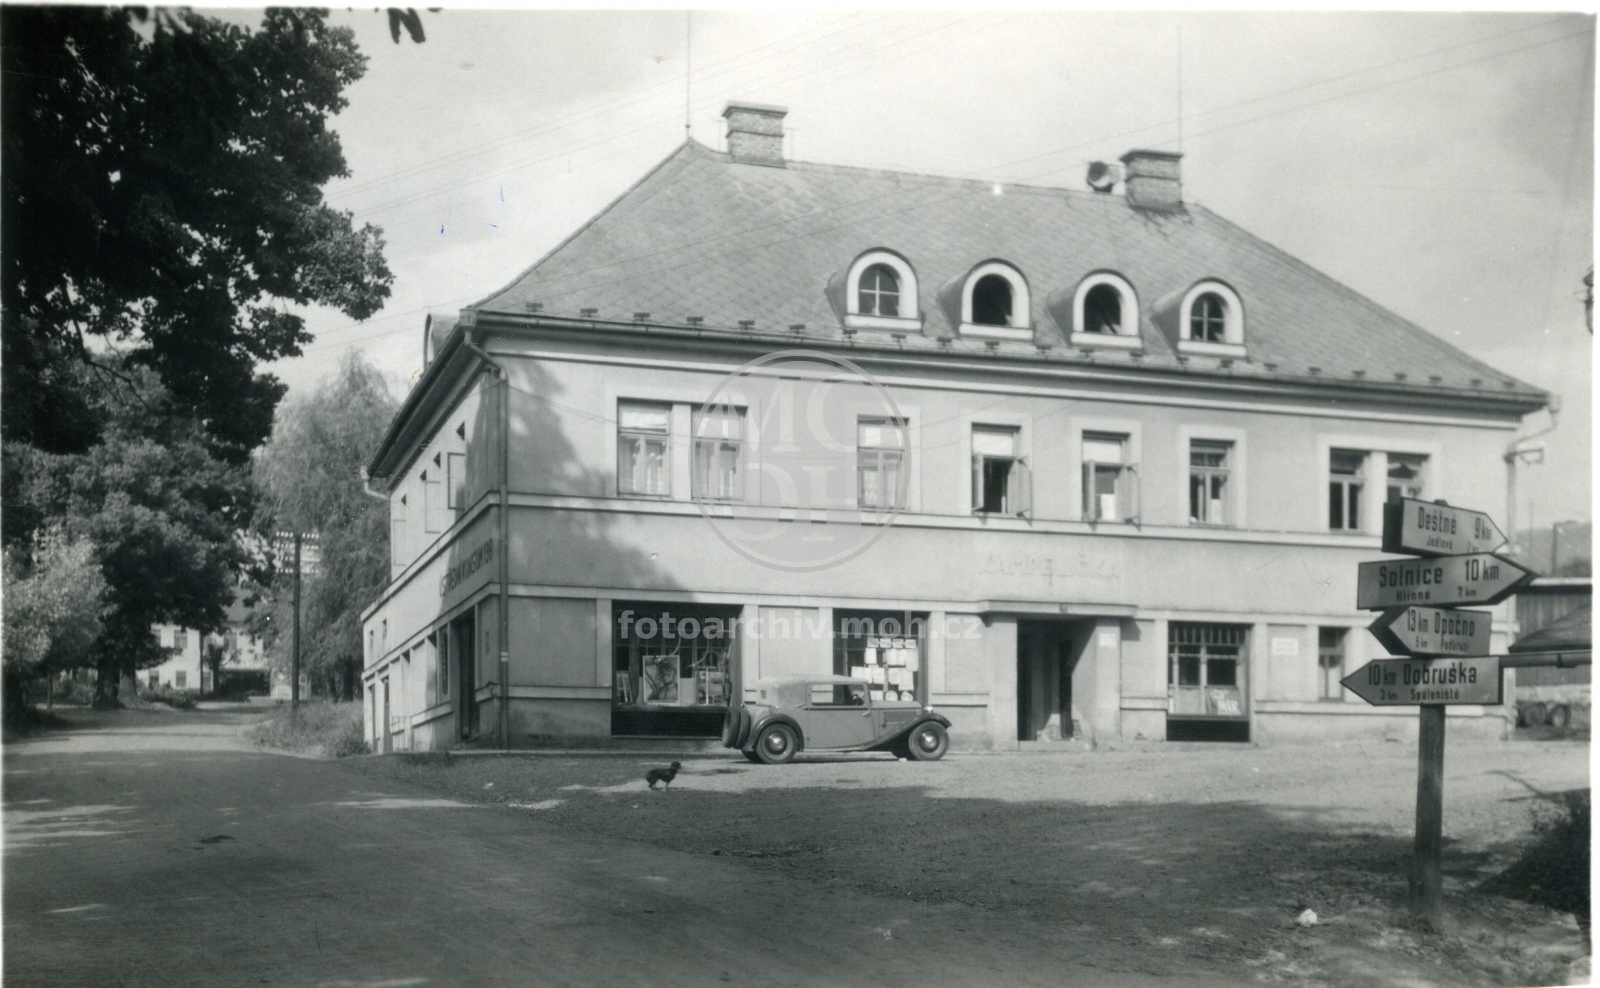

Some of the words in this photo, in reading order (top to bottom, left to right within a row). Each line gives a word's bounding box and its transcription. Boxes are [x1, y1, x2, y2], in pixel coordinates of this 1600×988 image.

[1417, 506, 1457, 535] Deštné
[1474, 517, 1480, 539] 9
[1481, 519, 1492, 541] km
[1379, 564, 1443, 588] Solnice
[1465, 559, 1479, 582] 10
[1483, 560, 1499, 580] km
[1465, 587, 1477, 597] km
[1407, 609, 1416, 632] 13
[1418, 612, 1429, 633] km
[1434, 611, 1475, 637] Opočno
[1420, 637, 1428, 648] km
[1368, 664, 1380, 686] 10
[1383, 665, 1397, 686] km
[1403, 662, 1477, 685] Dobruška
[1388, 688, 1398, 700] km
